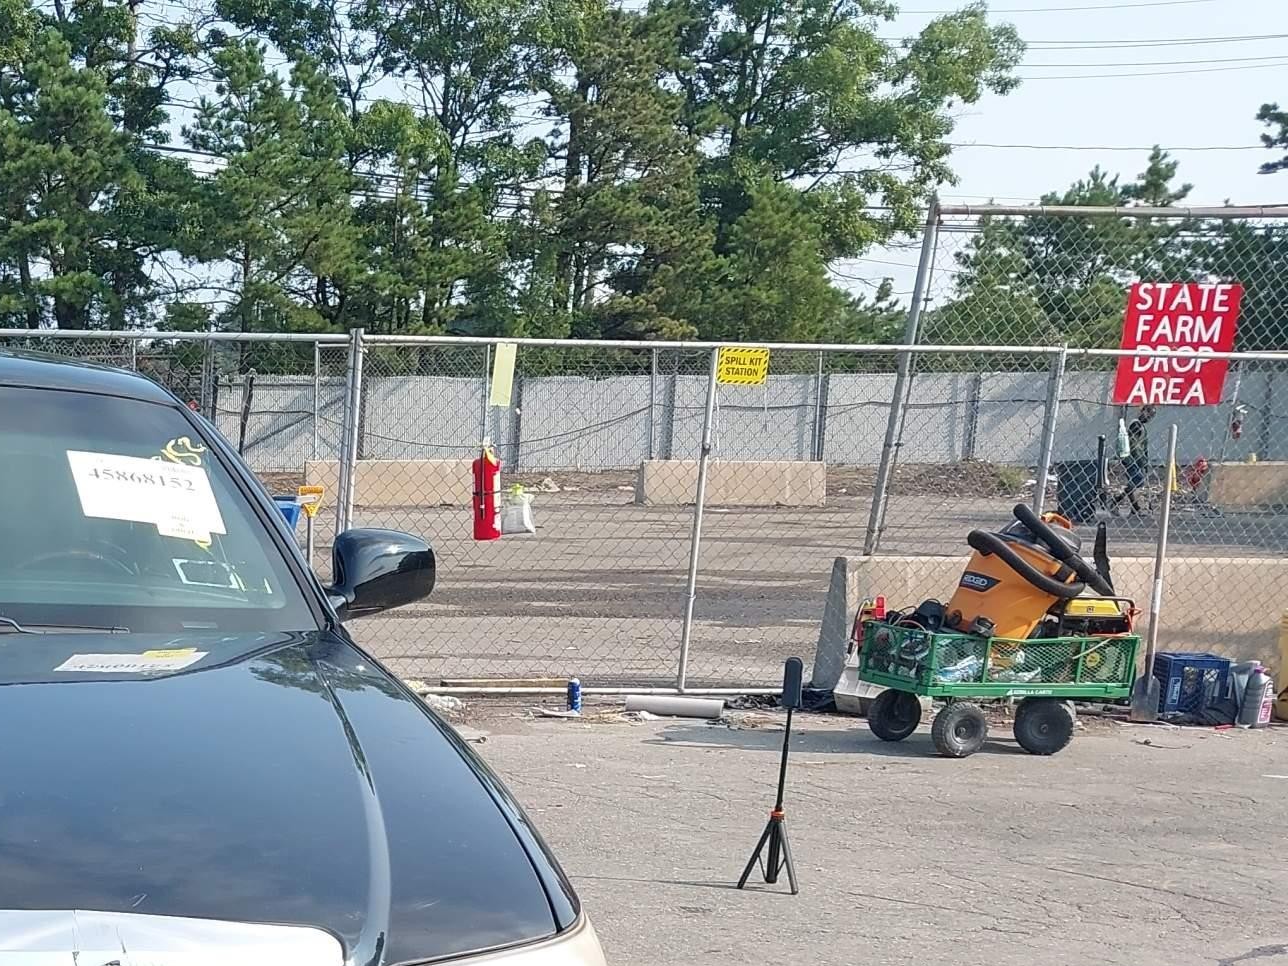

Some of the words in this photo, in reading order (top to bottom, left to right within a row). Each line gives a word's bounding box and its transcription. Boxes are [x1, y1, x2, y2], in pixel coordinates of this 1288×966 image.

[1136, 283, 1232, 312] STATE
[1134, 315, 1223, 343] FARM
[724, 356, 747, 366] SPILL
[749, 357, 763, 367] KIT
[725, 367, 759, 377] STATION
[1132, 345, 1216, 373] DROP
[1126, 377, 1205, 405] AREA
[88, 467, 196, 492] 45868152
